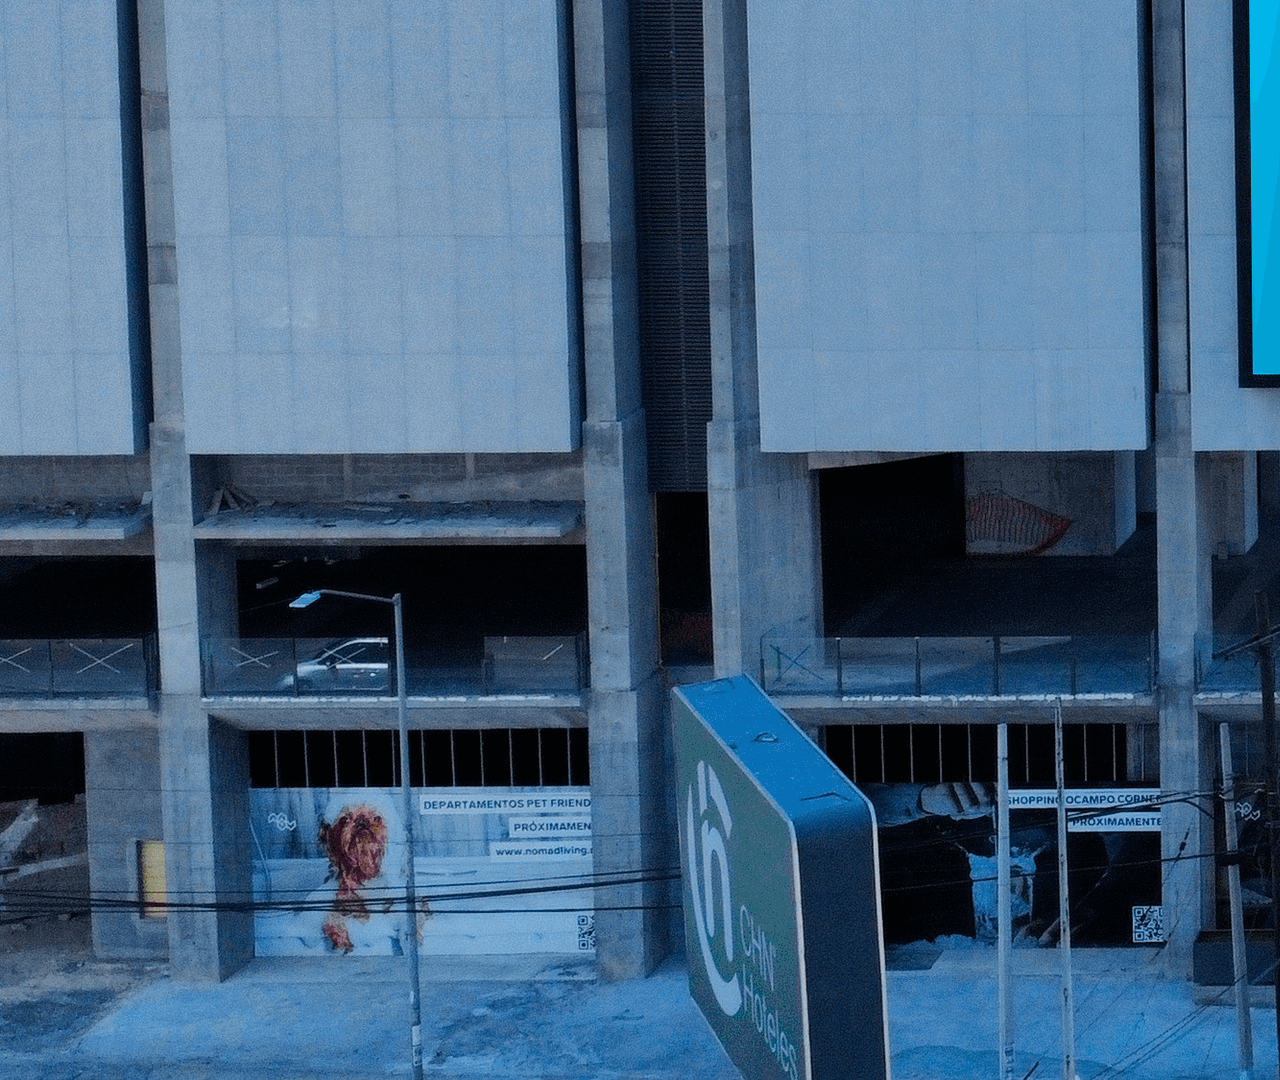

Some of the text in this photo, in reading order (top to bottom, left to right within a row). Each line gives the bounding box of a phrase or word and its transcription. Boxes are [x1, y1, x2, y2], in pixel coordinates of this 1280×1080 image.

[424, 799, 524, 810] DEPARTAMENTOS
[527, 799, 548, 808] PET
[1065, 795, 1115, 804] OCAMPO
